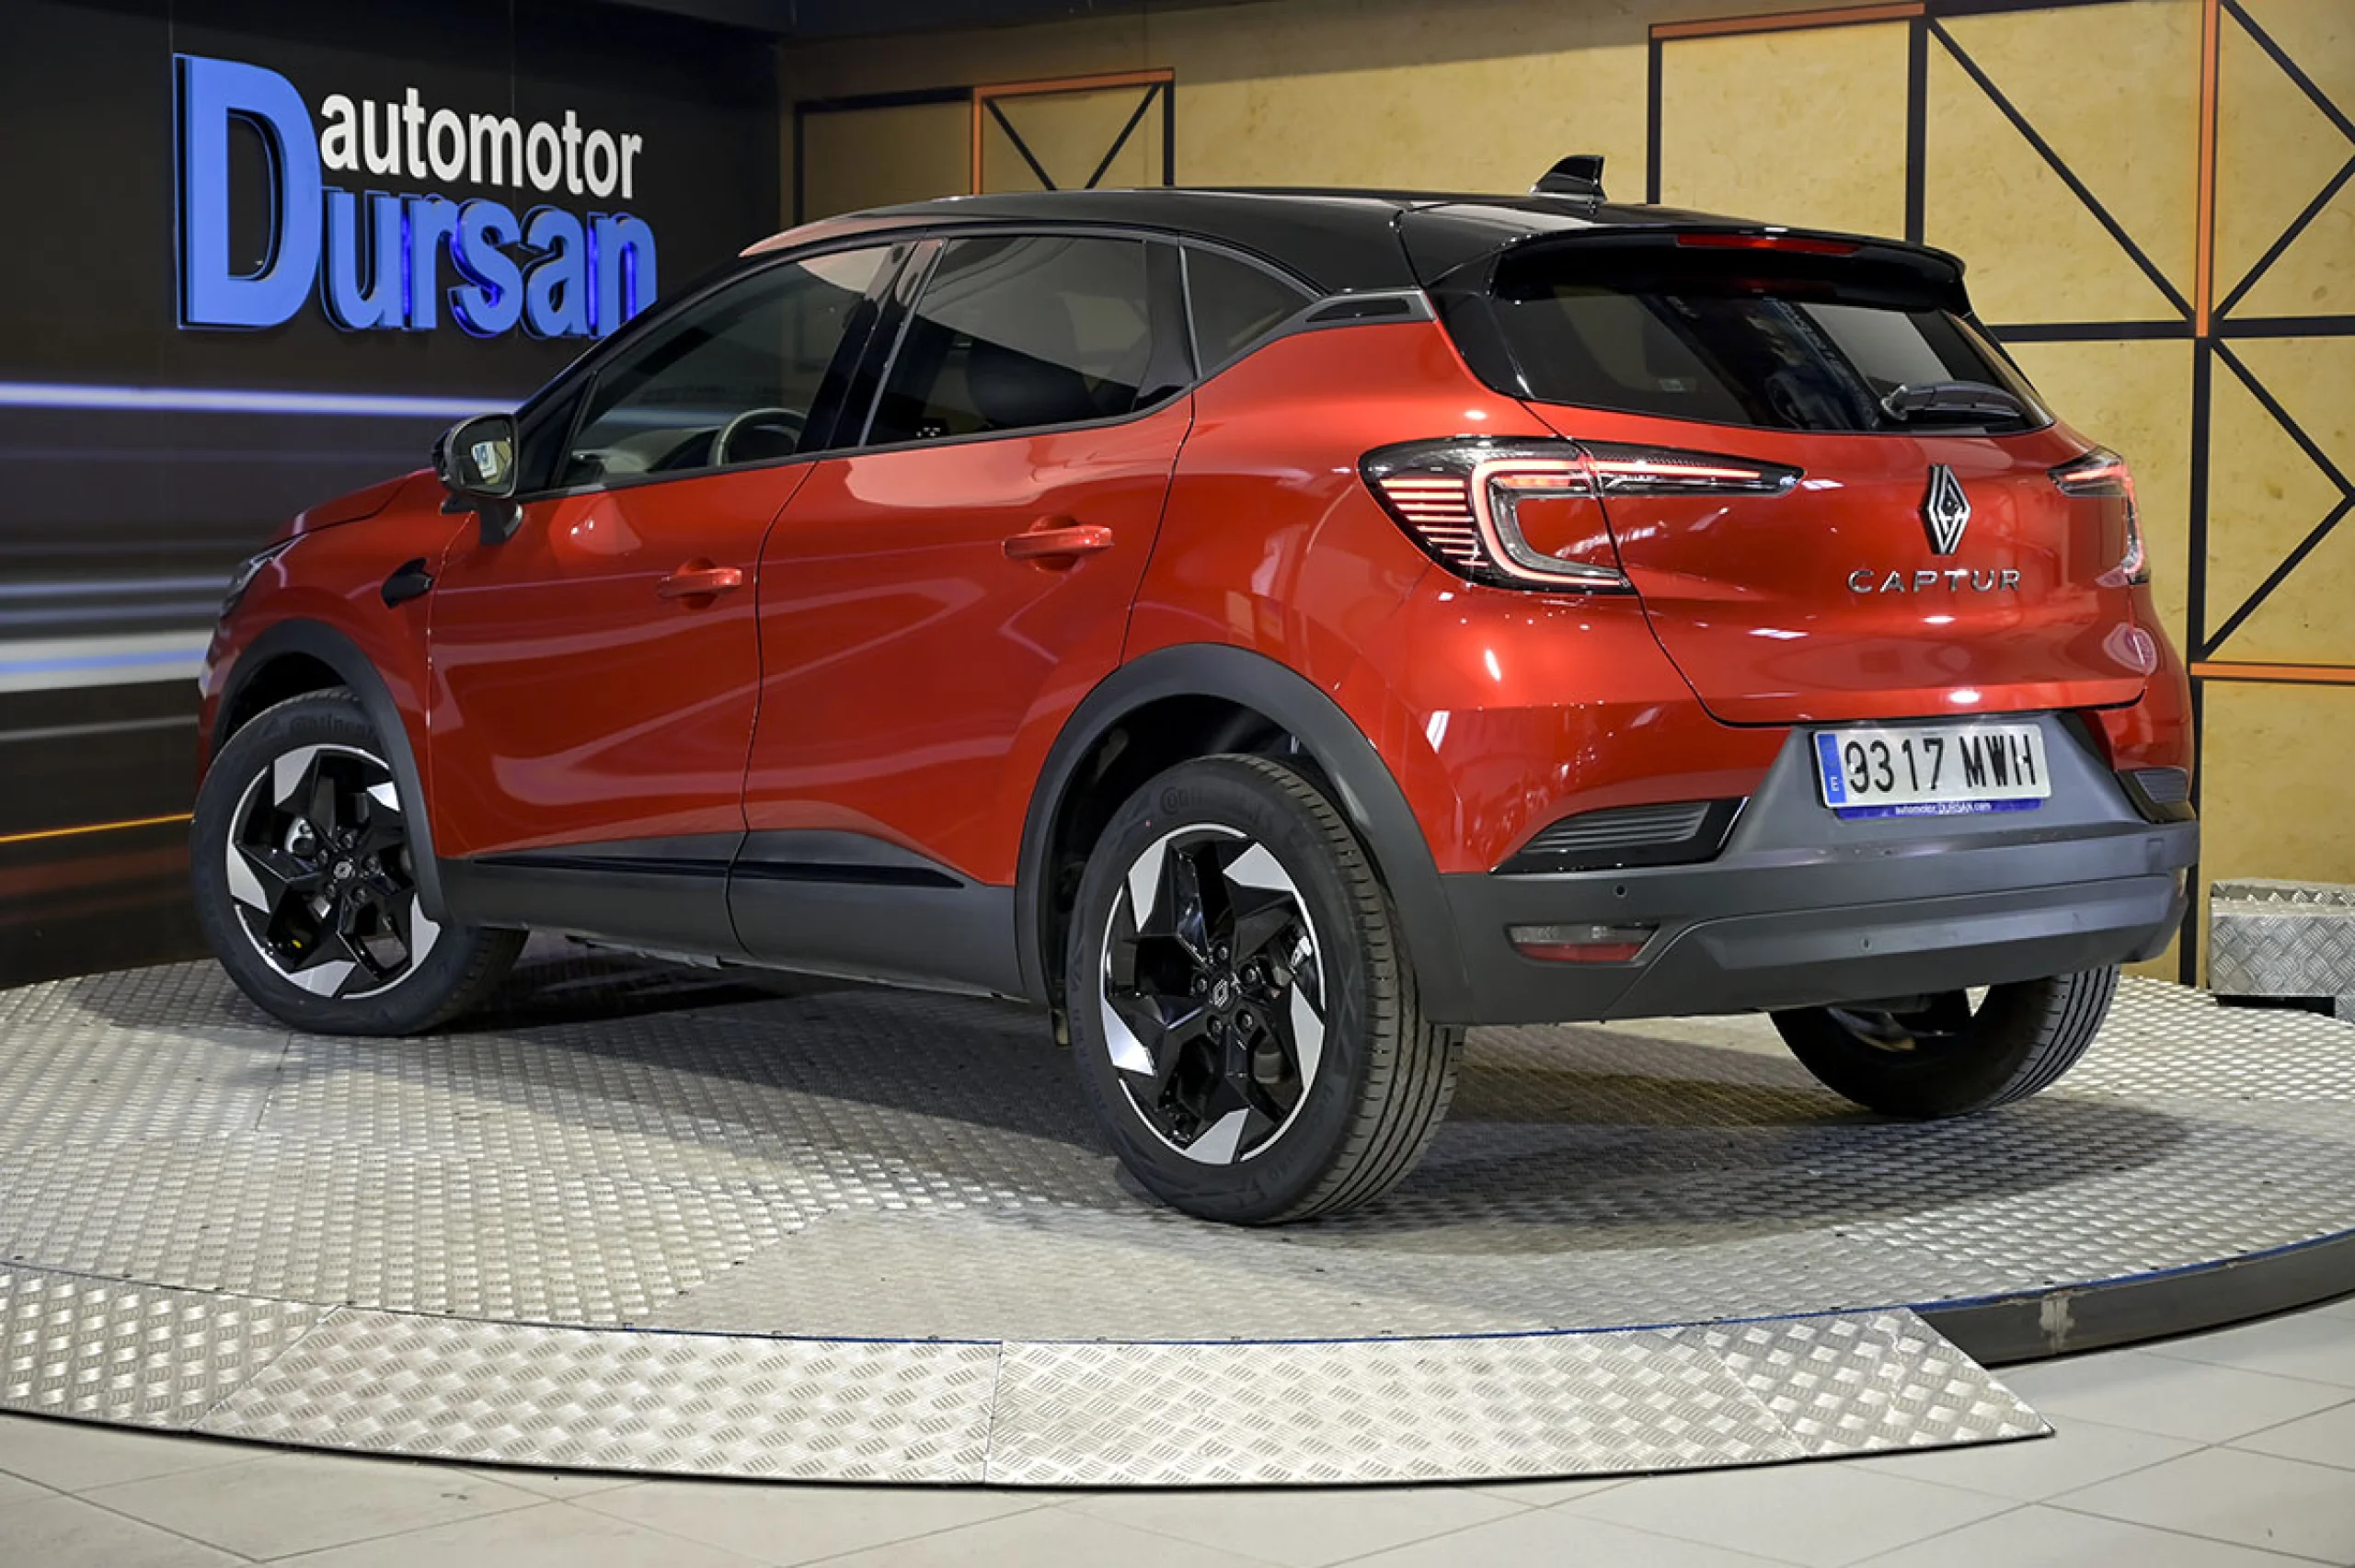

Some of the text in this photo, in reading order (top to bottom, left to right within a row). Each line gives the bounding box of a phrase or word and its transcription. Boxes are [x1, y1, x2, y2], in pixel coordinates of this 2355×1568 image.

[319, 87, 642, 199] automotor
[173, 52, 659, 339] Dursan
[1847, 568, 2021, 593] CAPTUR
[1830, 776, 1840, 792] E
[1844, 733, 2037, 794] 9317 MWH
